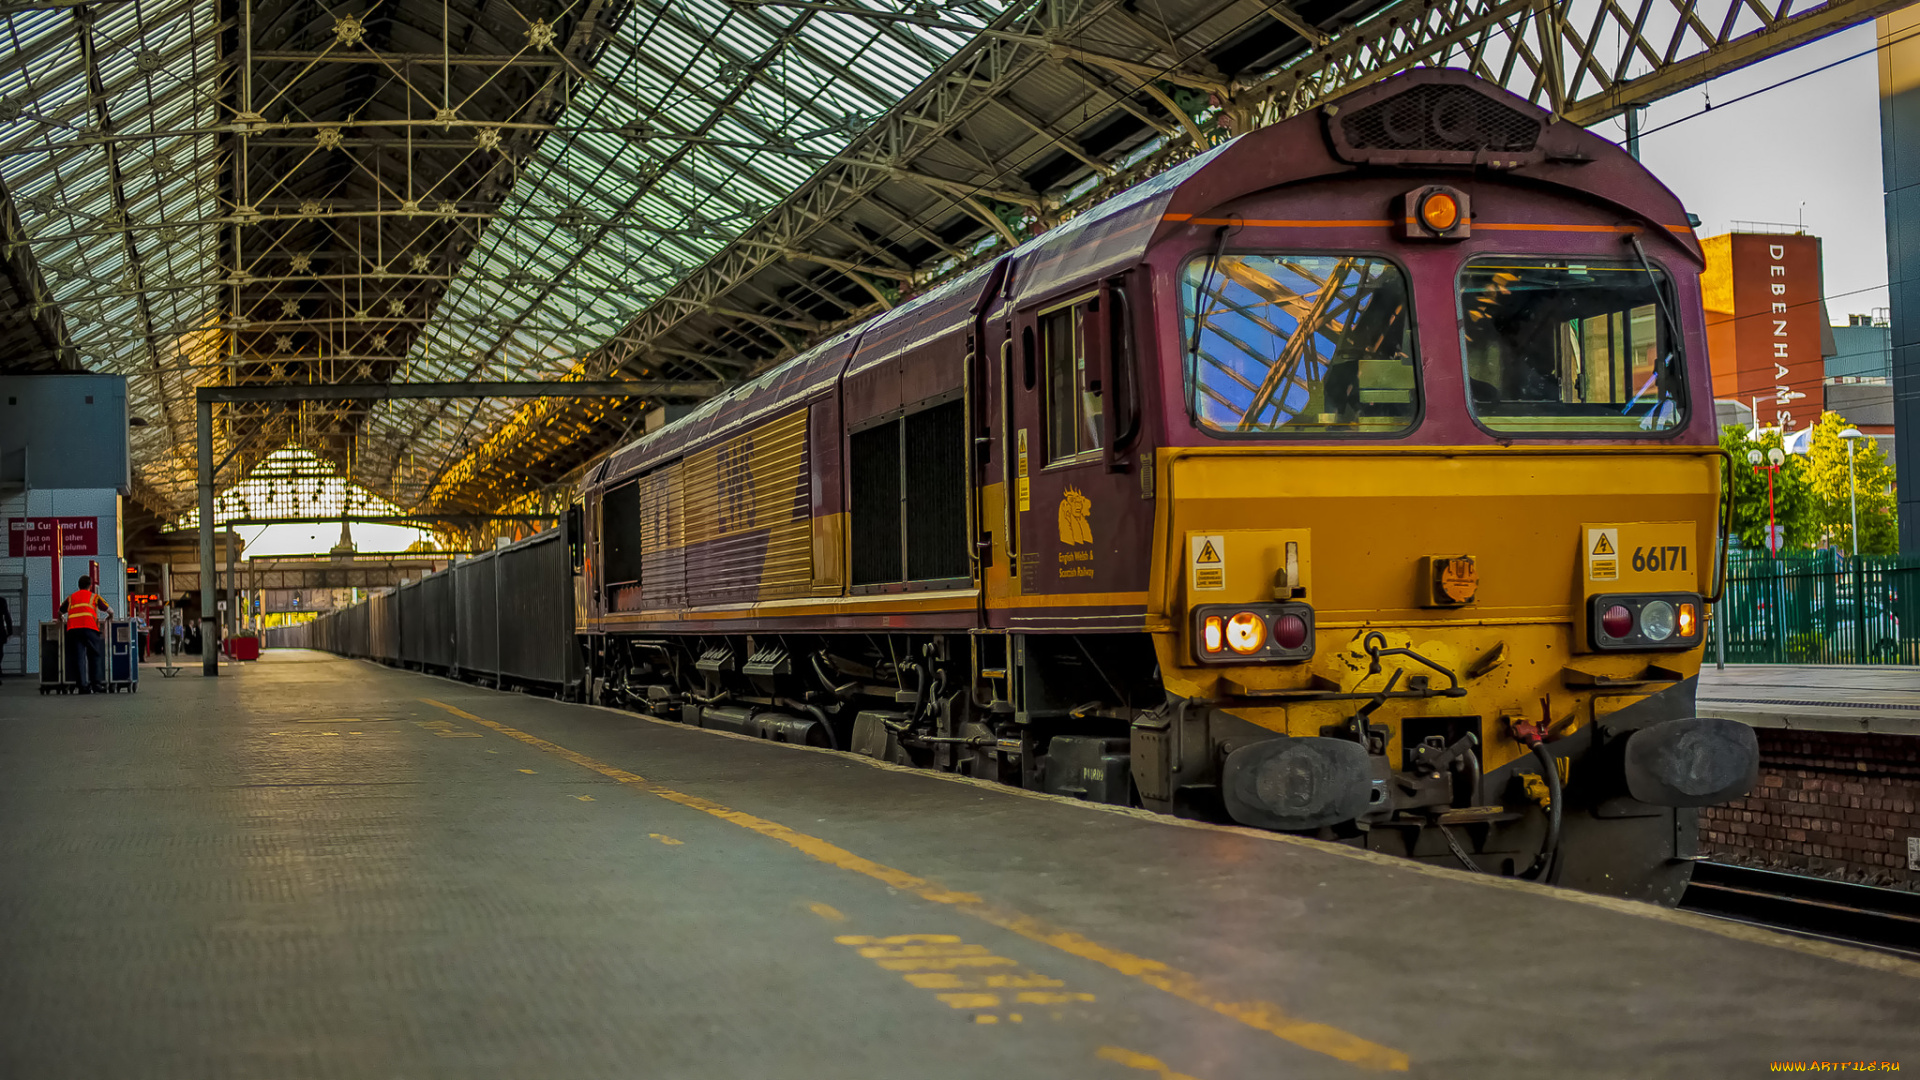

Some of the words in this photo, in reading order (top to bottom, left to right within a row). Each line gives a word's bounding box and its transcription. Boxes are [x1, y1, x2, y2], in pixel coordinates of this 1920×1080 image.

[1769, 244, 1791, 425] DEBENHAMS
[79, 521, 94, 529] Lift
[1632, 546, 1687, 572] 66171
